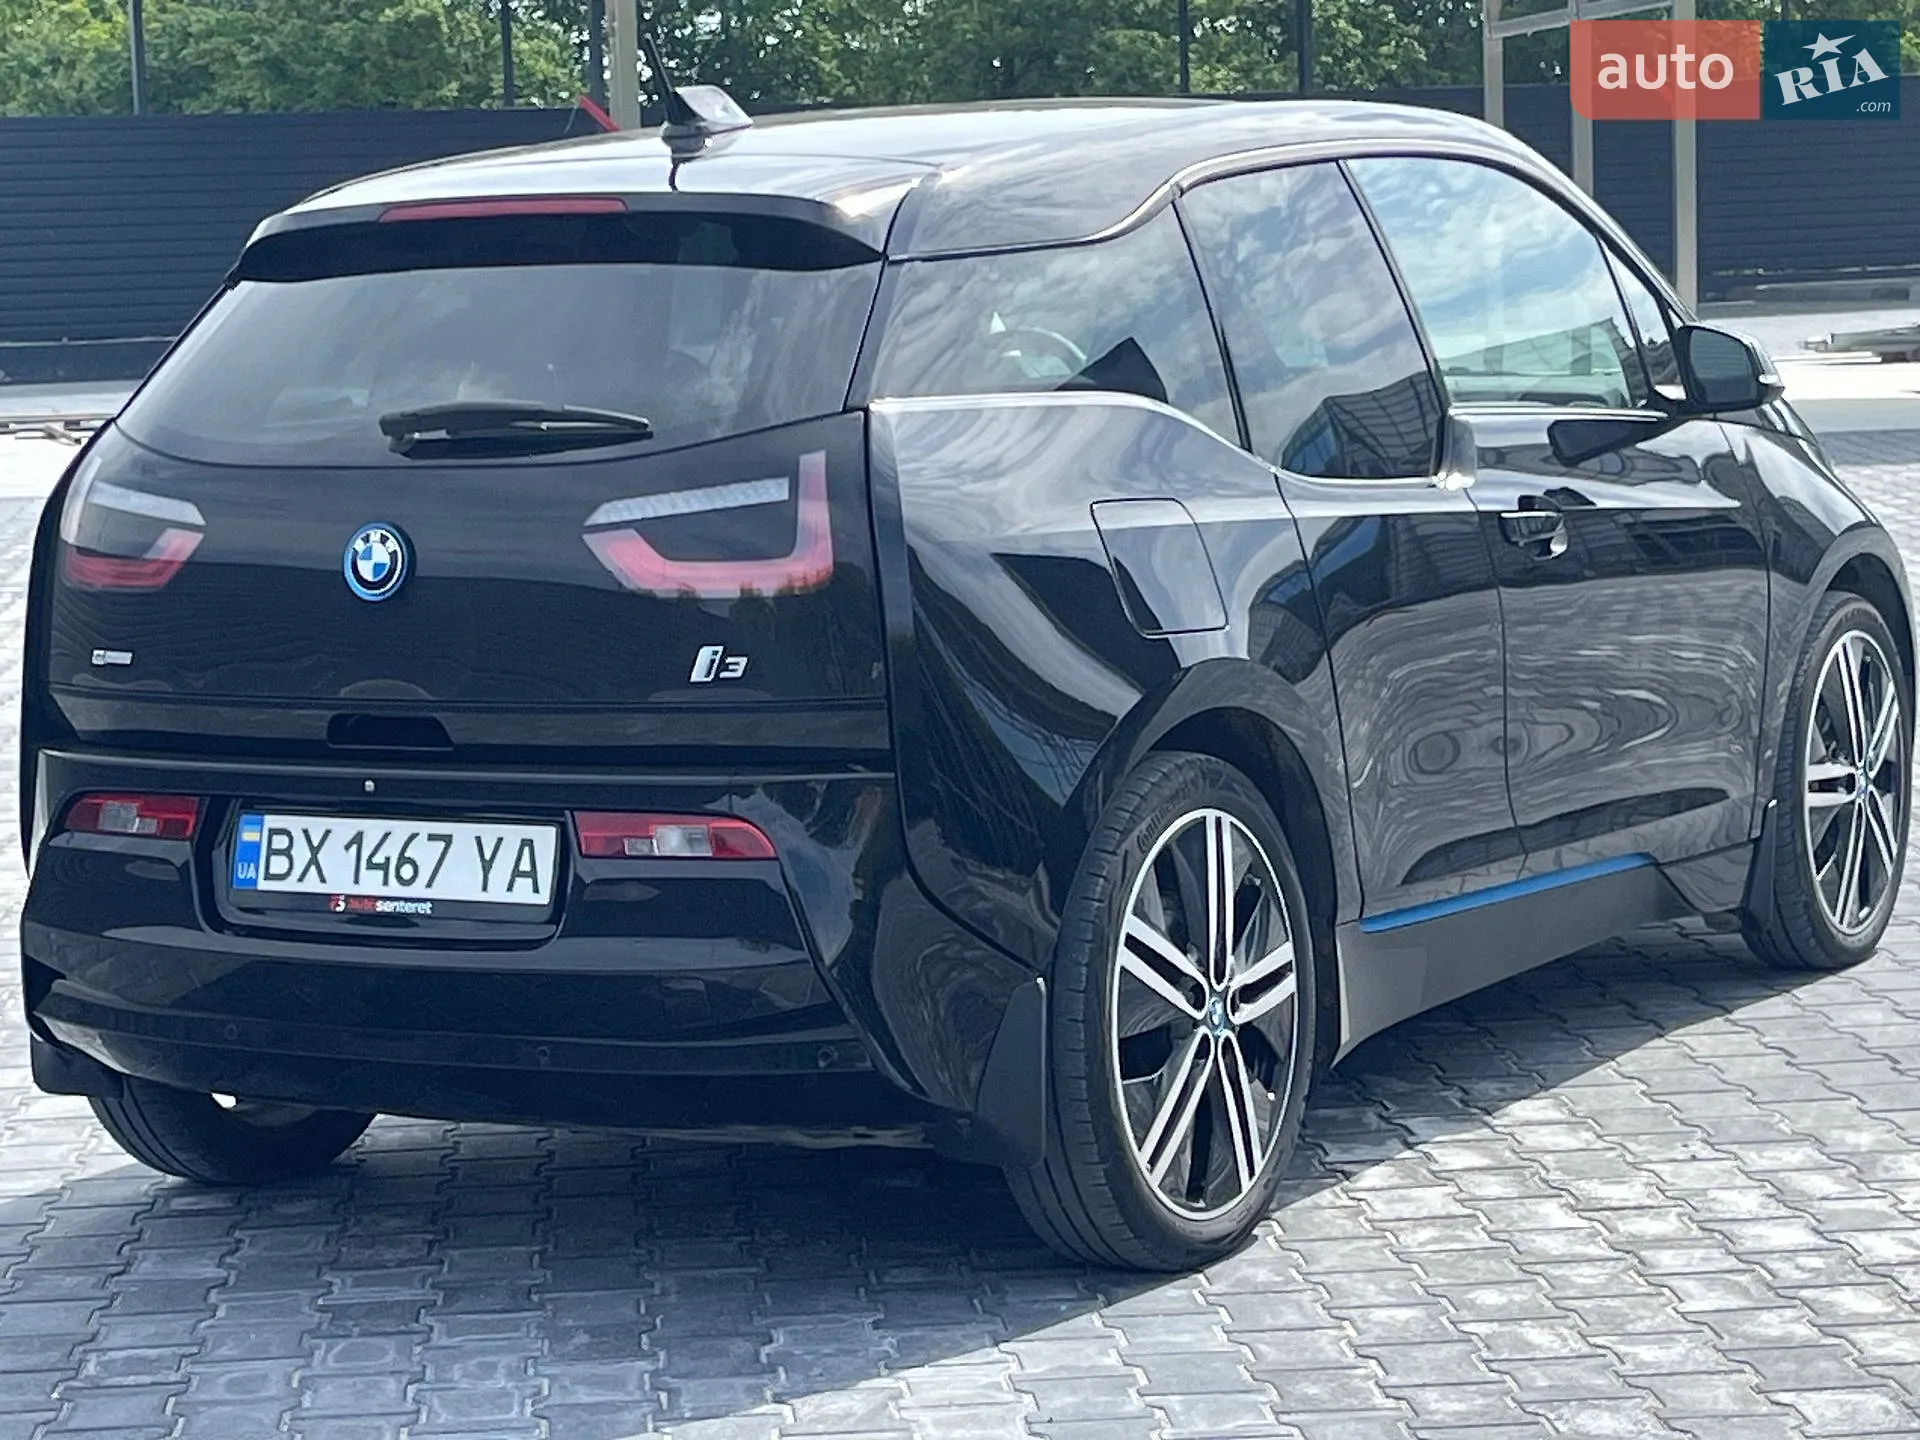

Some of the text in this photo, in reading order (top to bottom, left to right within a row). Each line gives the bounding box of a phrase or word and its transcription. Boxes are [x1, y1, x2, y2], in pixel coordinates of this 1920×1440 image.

[690, 645, 748, 682] i3
[238, 862, 257, 880] UA
[263, 827, 540, 894] BX 1467 YA
